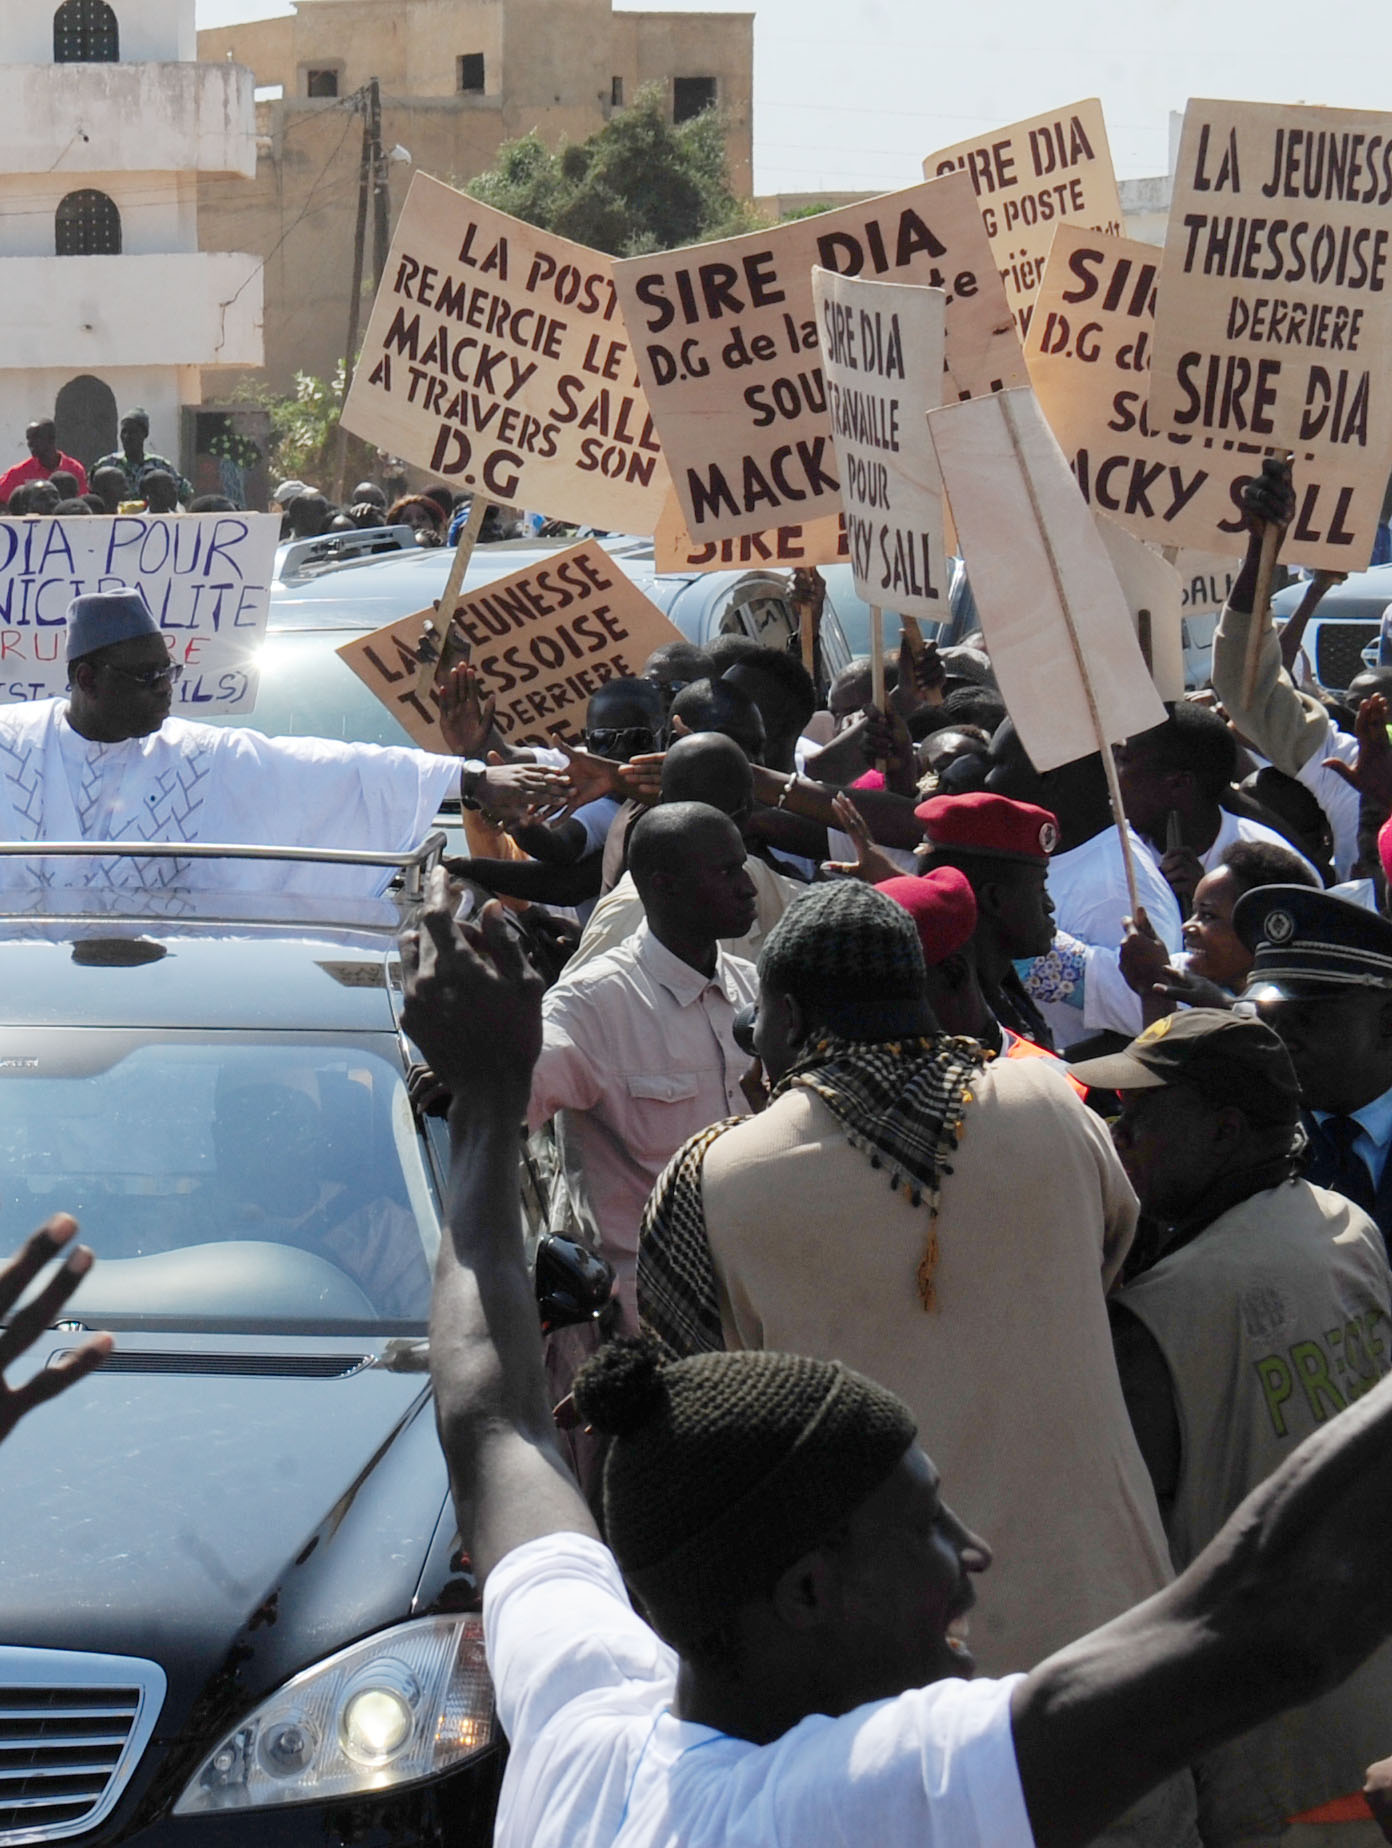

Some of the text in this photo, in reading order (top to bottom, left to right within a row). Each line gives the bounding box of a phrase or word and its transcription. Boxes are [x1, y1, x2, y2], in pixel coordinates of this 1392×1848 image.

[1028, 116, 1095, 177] DIA
[1193, 124, 1240, 193] LA
[1003, 178, 1085, 232] POSTE
[458, 222, 619, 322] LA POST
[635, 208, 948, 334] SIRE DIA
[1182, 214, 1389, 291] THIESSOISE
[393, 254, 627, 381] REMERCIE LE
[646, 337, 710, 386] D.G
[721, 325, 777, 370] de
[782, 313, 819, 354] la
[823, 298, 905, 380] SIRE DIA
[1039, 312, 1104, 363] D.G
[1226, 296, 1364, 351] DERRIERE
[383, 306, 661, 453] MACKY SALL
[743, 367, 829, 428] SOU
[827, 379, 900, 453] TRAVAILLE
[1173, 352, 1281, 434] SIRE
[1299, 365, 1371, 446] DIA
[368, 353, 656, 488] A TRAVERS SON
[429, 422, 524, 499] D.G
[686, 434, 842, 524] MACK
[847, 452, 890, 511] POUR
[1071, 448, 1356, 545] ACKY SLL
[105, 518, 248, 580] POUR
[879, 522, 939, 600] SALL
[454, 553, 613, 647] EUNESSE
